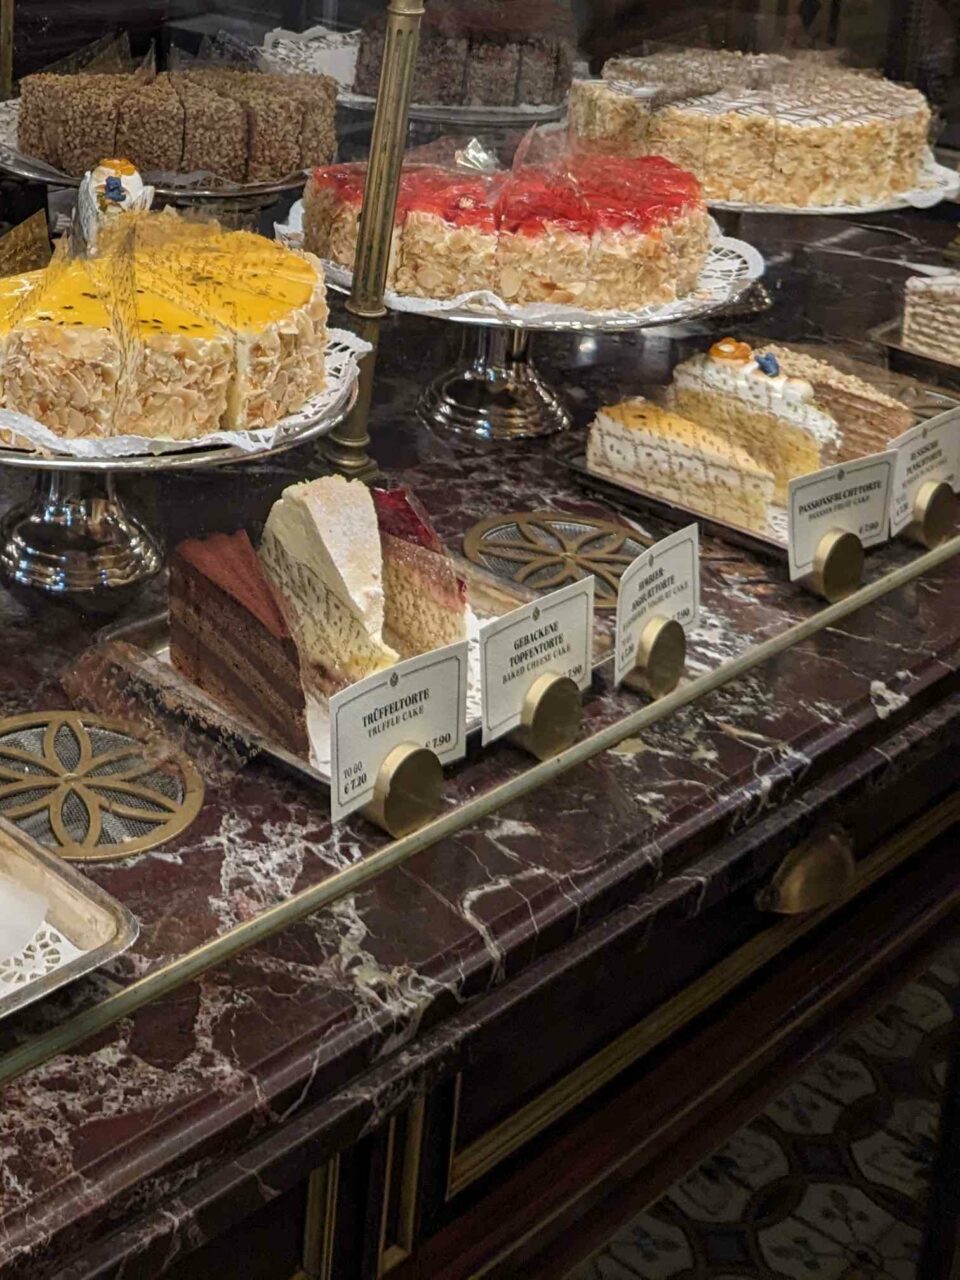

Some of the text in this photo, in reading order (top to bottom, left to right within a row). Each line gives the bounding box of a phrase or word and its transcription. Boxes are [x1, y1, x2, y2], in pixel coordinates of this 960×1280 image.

[509, 633, 564, 668] TOPFENTORTE
[513, 620, 559, 651] GEBACKENE
[502, 664, 525, 685] BAKED
[526, 653, 552, 672] CHEESE
[361, 688, 430, 728] TRÜFFELTORTE
[368, 705, 425, 738] TRUFFLE CAKE
[343, 761, 363, 779] TO GO
